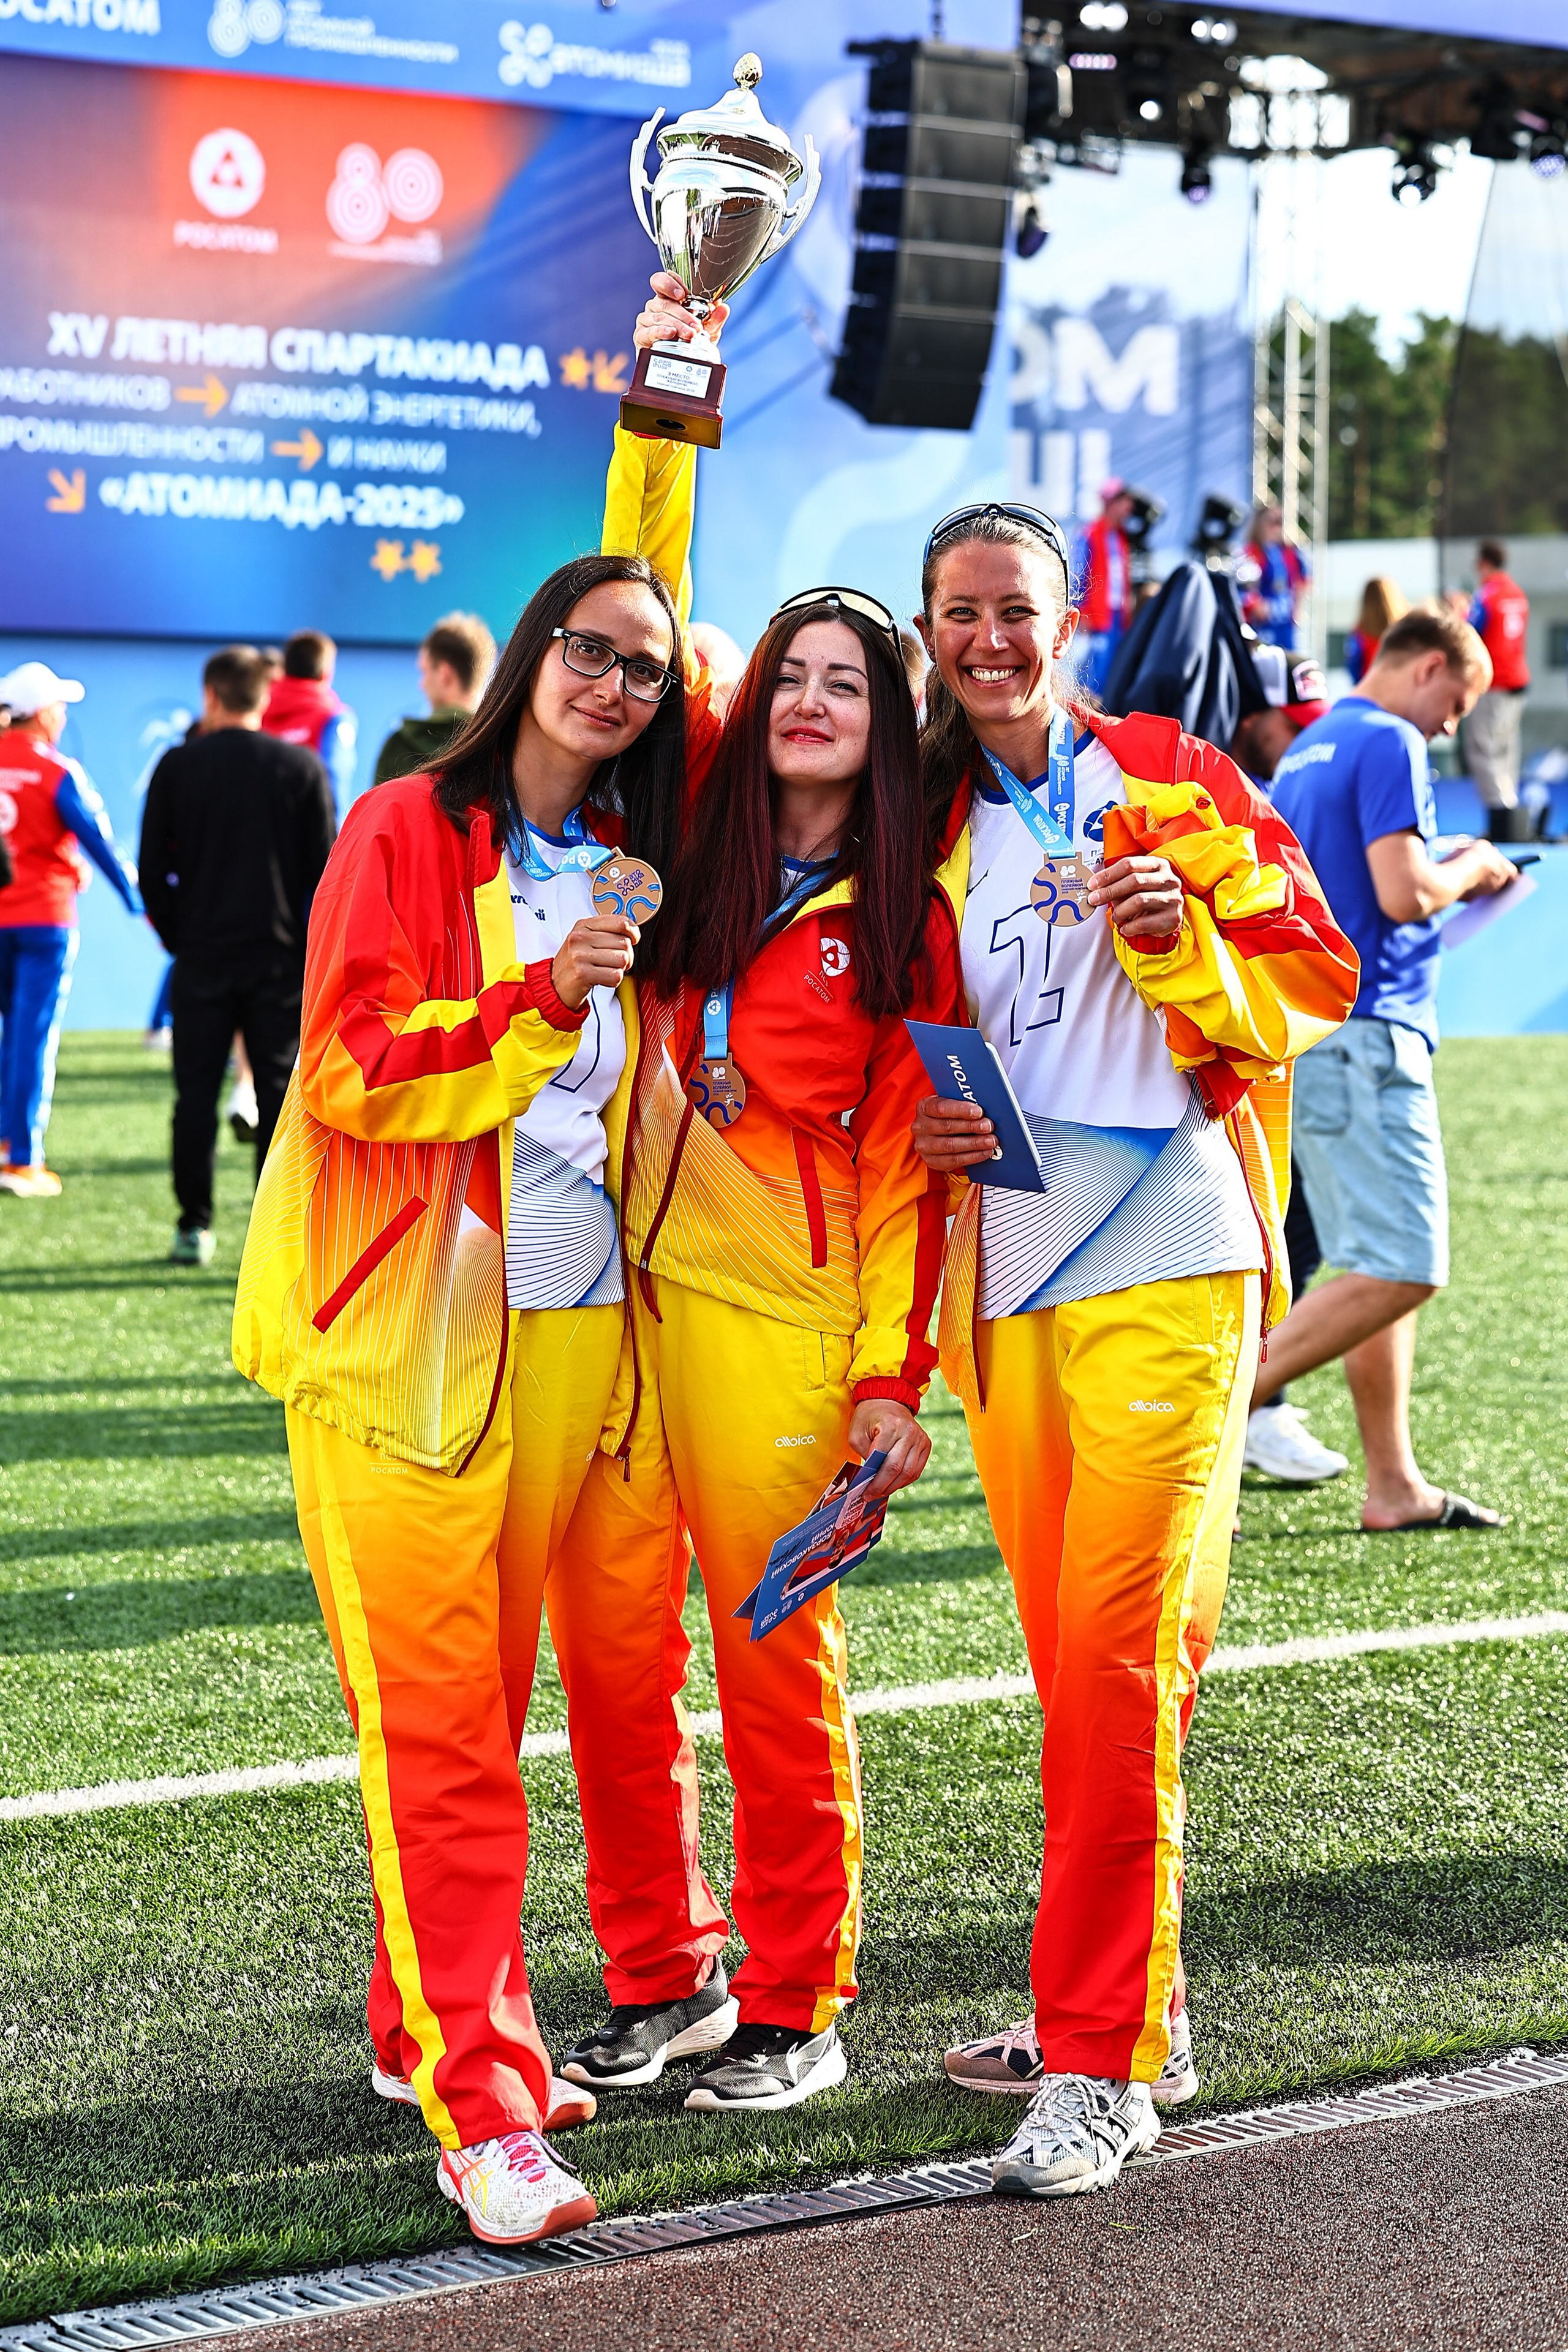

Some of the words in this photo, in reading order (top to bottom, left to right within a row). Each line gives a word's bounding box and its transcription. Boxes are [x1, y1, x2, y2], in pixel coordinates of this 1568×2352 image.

[47, 311, 109, 358] XV
[270, 327, 550, 393] СПАРТАКИАДА
[804, 974, 830, 1003] РОСАТОМ
[946, 1054, 978, 1104] АТОМ
[771, 1531, 832, 1580] БОРЗАКОВСКИЙ
[811, 1523, 835, 1544] ЮРИЙ
